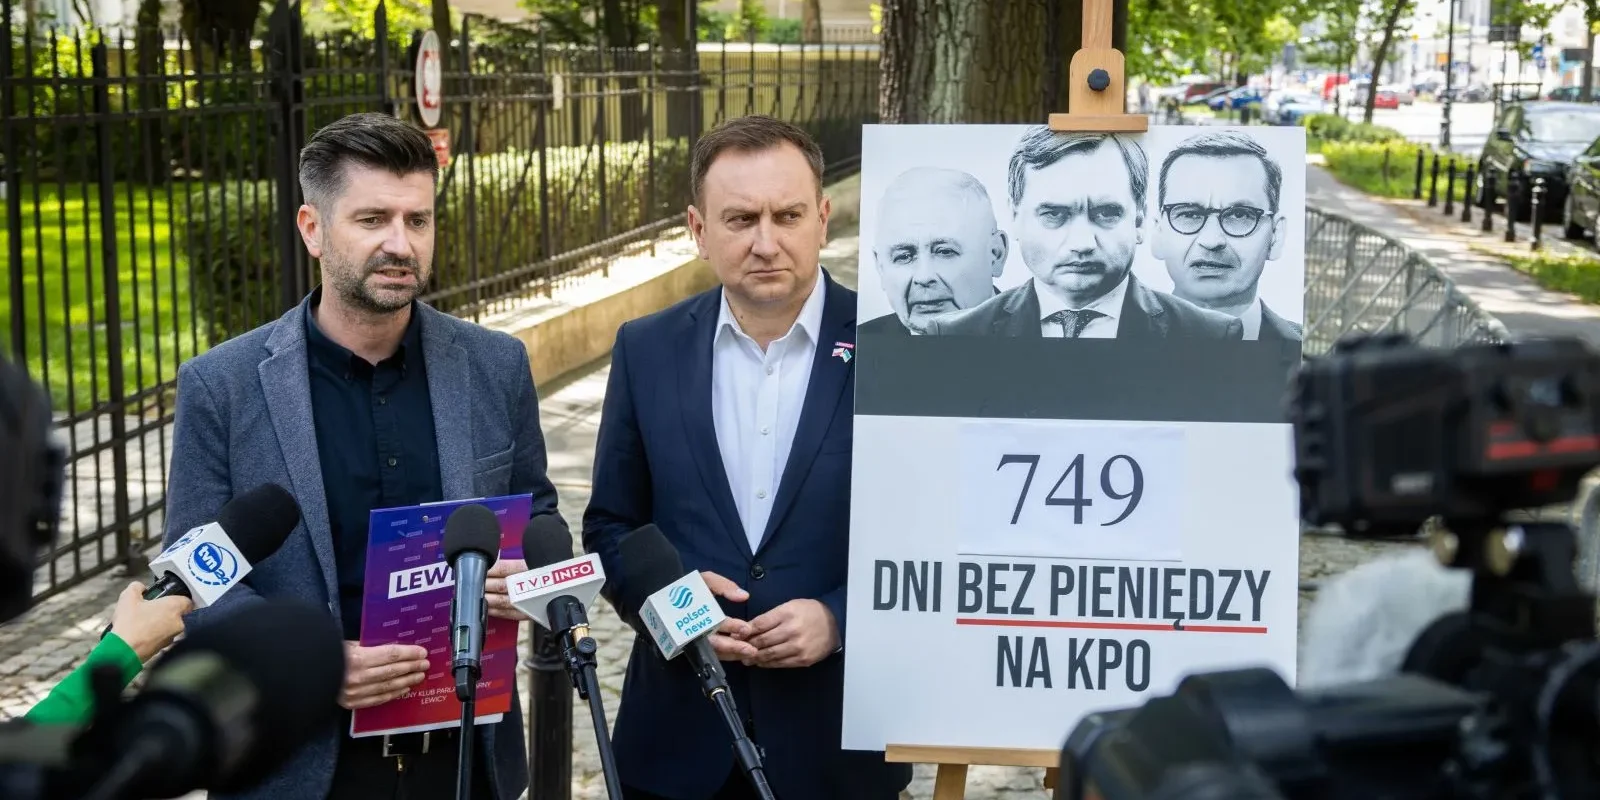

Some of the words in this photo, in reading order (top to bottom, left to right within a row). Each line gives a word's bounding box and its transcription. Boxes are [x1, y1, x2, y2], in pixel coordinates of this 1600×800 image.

[996, 453, 1144, 526] 749
[198, 545, 218, 570] tvn
[214, 569, 231, 585] 24
[516, 575, 550, 591] TVP
[554, 564, 592, 581] INFO
[873, 559, 942, 612] DNI
[957, 562, 1036, 616] BEZ
[1050, 565, 1271, 630] PIENIĘDZY
[676, 604, 710, 630] polsat
[684, 616, 713, 636] news
[996, 635, 1053, 689] NA
[1067, 637, 1150, 692] KPO
[418, 688, 436, 697] KLUB
[421, 695, 447, 705] LEWICY
